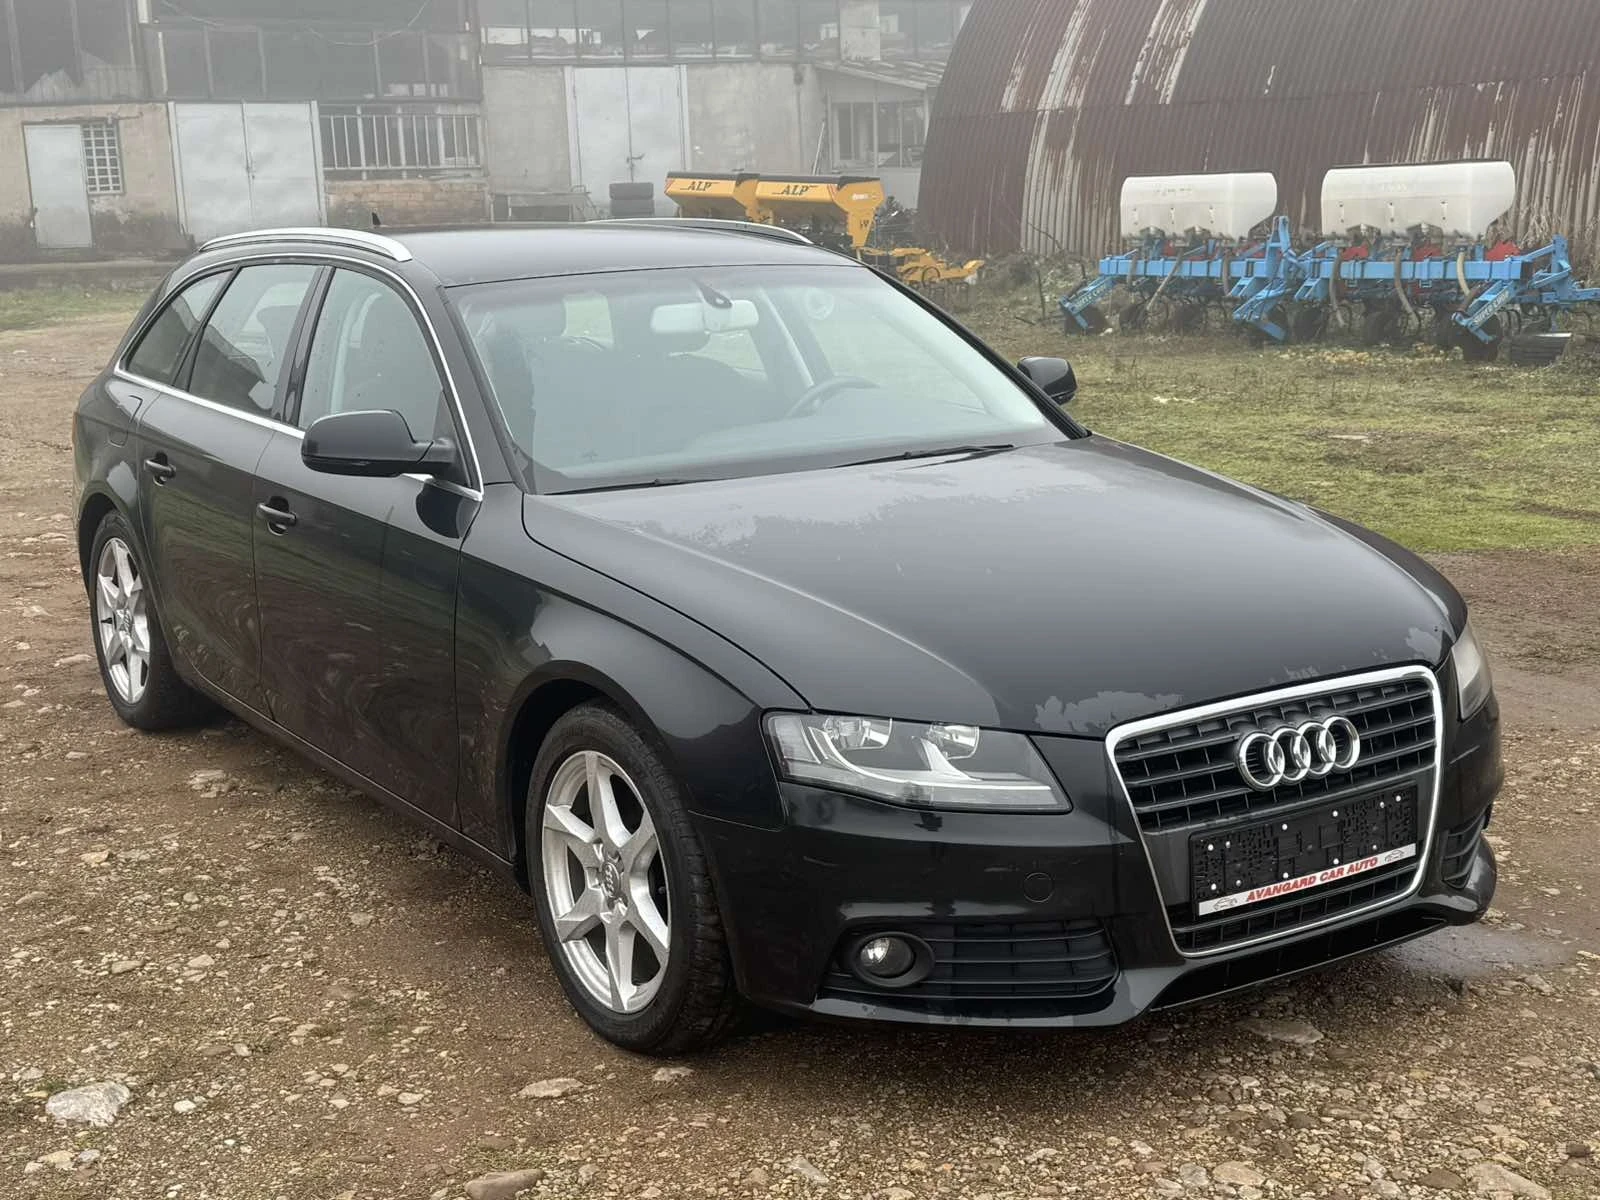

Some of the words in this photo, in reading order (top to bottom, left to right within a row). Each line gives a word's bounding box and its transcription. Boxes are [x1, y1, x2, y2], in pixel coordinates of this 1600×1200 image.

[688, 181, 712, 192] ALP
[781, 185, 809, 196] ALP
[1247, 876, 1317, 901] AVANGARD
[1320, 868, 1345, 881] CAR
[1347, 857, 1378, 874] AUTO
